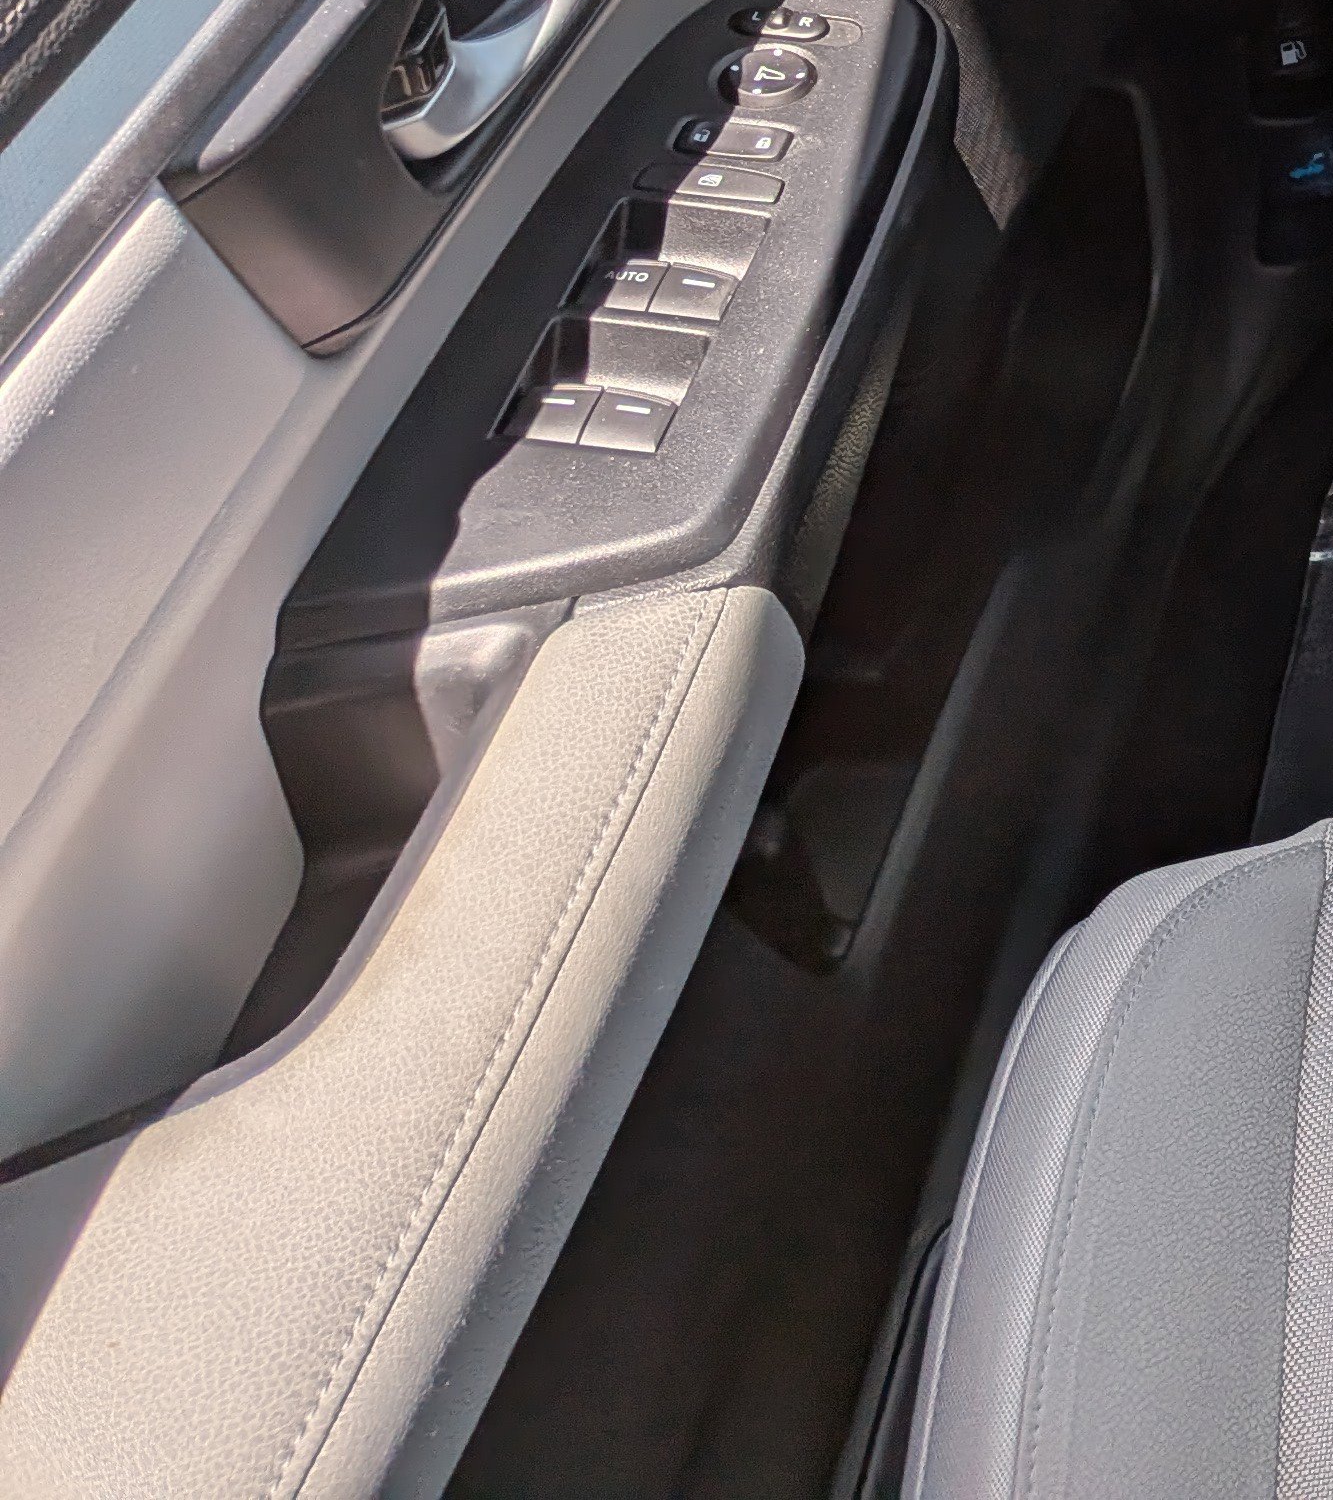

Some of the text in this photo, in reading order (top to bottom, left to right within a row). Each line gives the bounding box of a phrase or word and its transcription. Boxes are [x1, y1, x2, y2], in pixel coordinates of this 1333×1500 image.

[752, 11, 761, 20] L
[798, 15, 814, 27] R
[604, 269, 649, 283] AUTO
